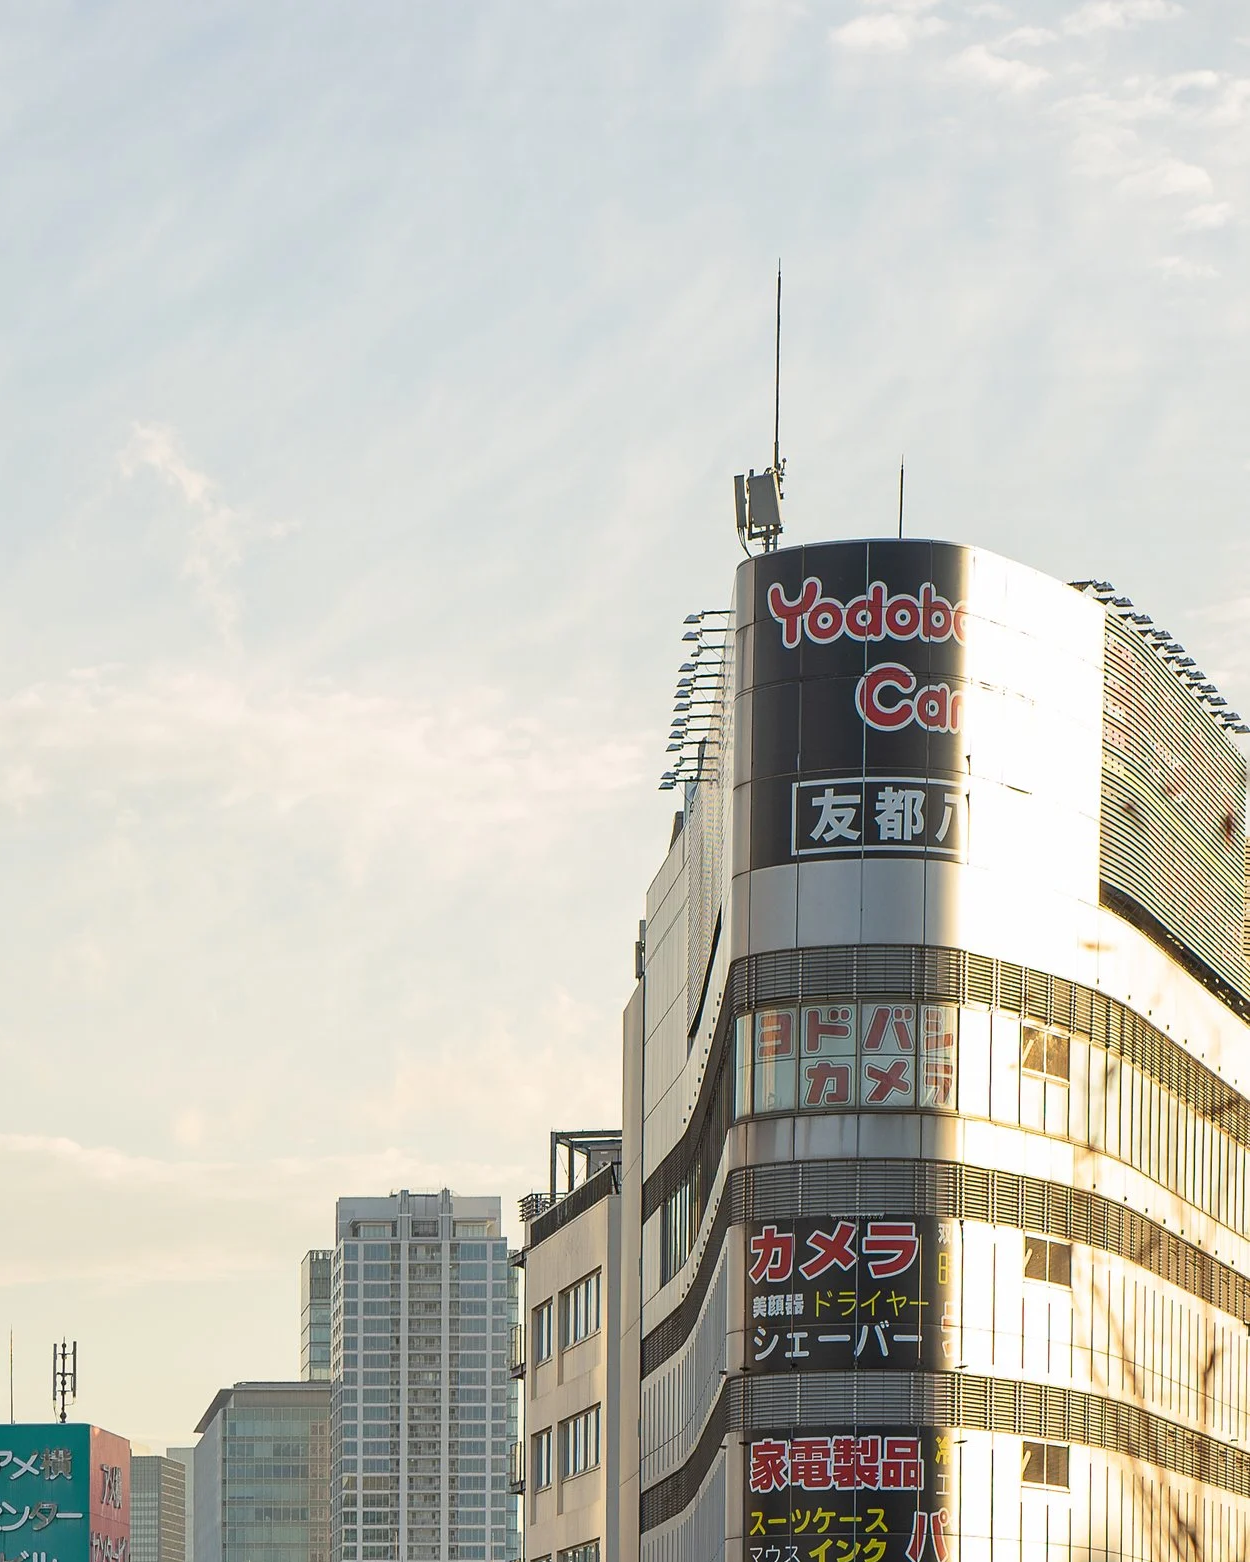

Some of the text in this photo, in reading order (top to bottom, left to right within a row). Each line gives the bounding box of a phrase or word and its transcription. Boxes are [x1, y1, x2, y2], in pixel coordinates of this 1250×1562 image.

[855, 662, 965, 734] Ca
[758, 1007, 953, 1058] ヨドバシ
[805, 1060, 953, 1105] カメラ
[749, 1221, 918, 1284] カメラ
[814, 1288, 929, 1317] ドライヤー
[749, 1436, 924, 1493] 家電製品
[749, 1507, 889, 1535] スーツケース
